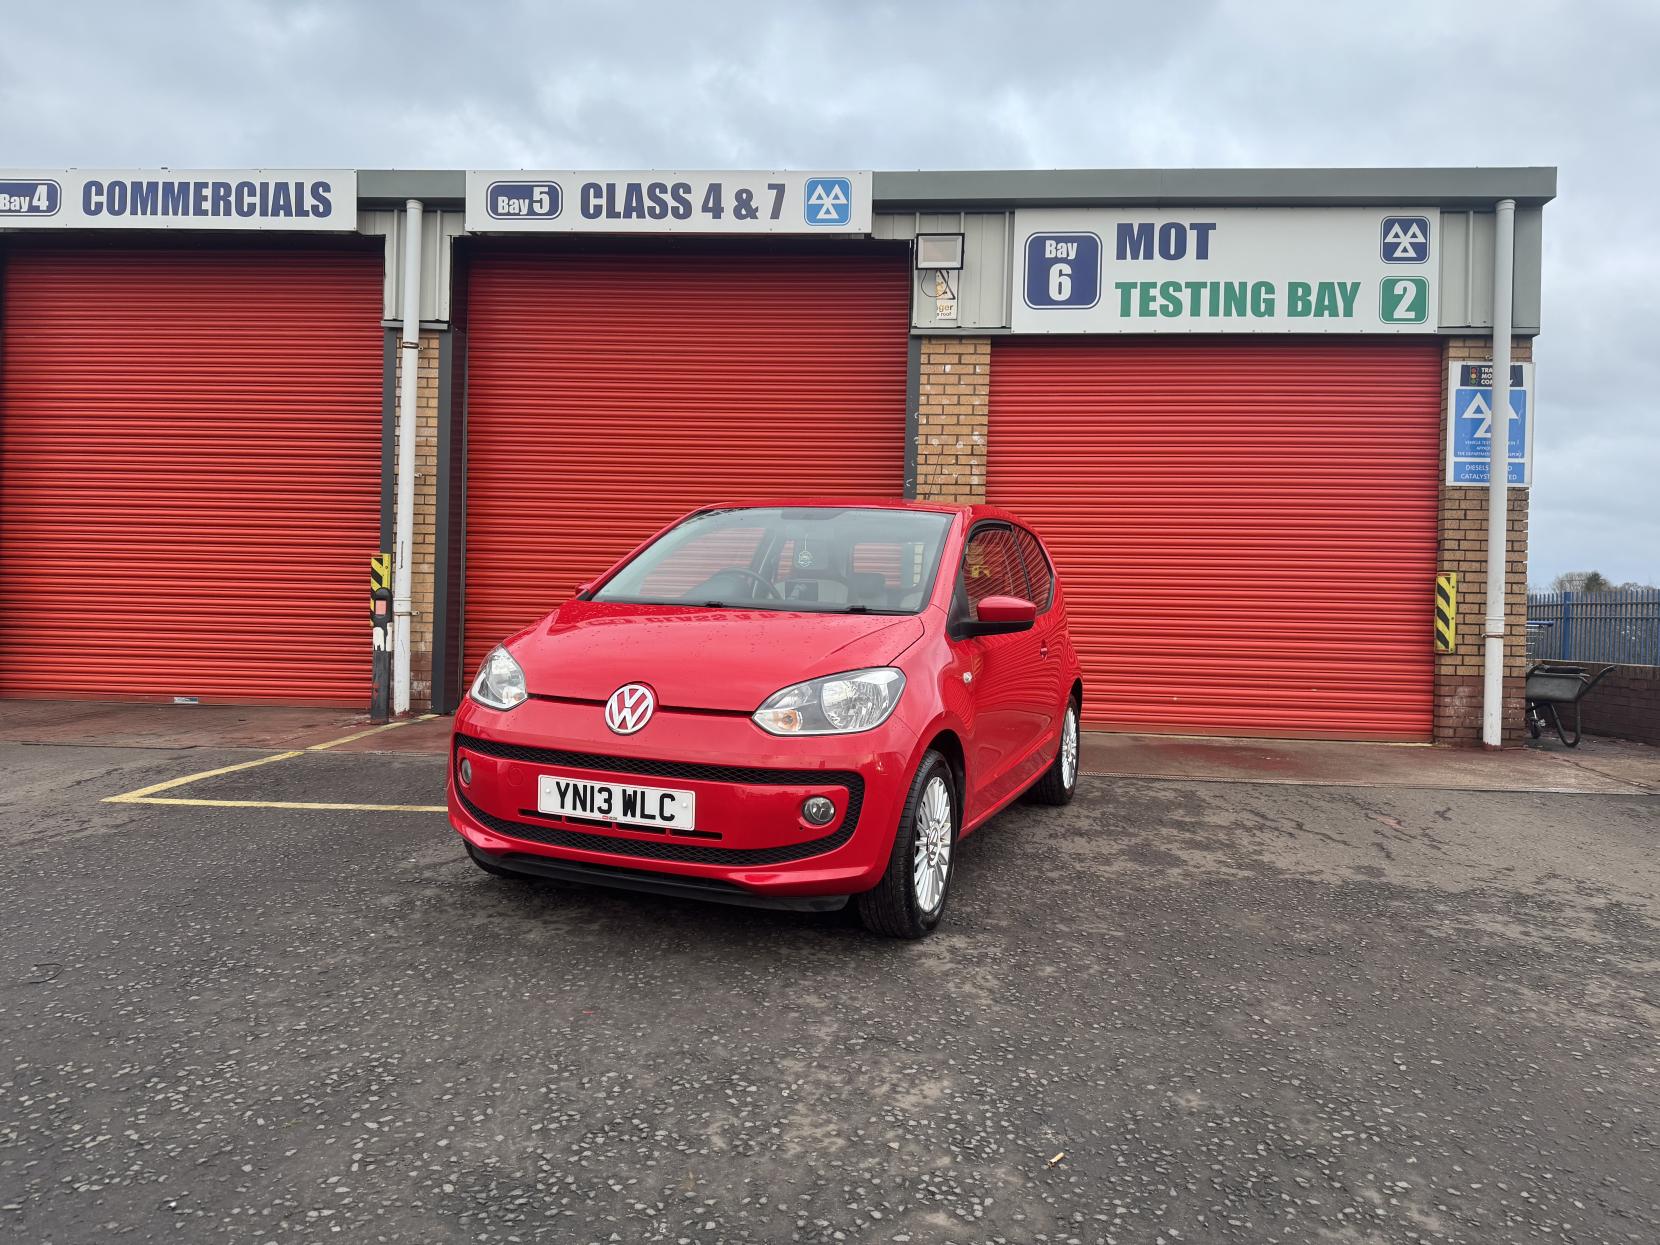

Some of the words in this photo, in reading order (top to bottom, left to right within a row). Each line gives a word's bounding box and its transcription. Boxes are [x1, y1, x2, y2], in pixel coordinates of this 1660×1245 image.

[0, 193, 30, 212] Bay
[32, 184, 49, 211] 4
[83, 180, 332, 219] COMMERCIALS
[497, 196, 530, 216] Bay
[532, 186, 550, 214] 5
[580, 182, 693, 220] CLASS
[702, 182, 725, 220] 4
[732, 188, 759, 221] &
[767, 182, 786, 220] 7
[1045, 239, 1078, 260] Bay
[1116, 222, 1217, 261] MOT
[1048, 262, 1072, 302] 6
[1115, 281, 1276, 318] TESTING
[1287, 281, 1362, 318] BAY
[1394, 281, 1416, 319] 2
[556, 782, 613, 815] YN13
[621, 788, 676, 822] WLC
